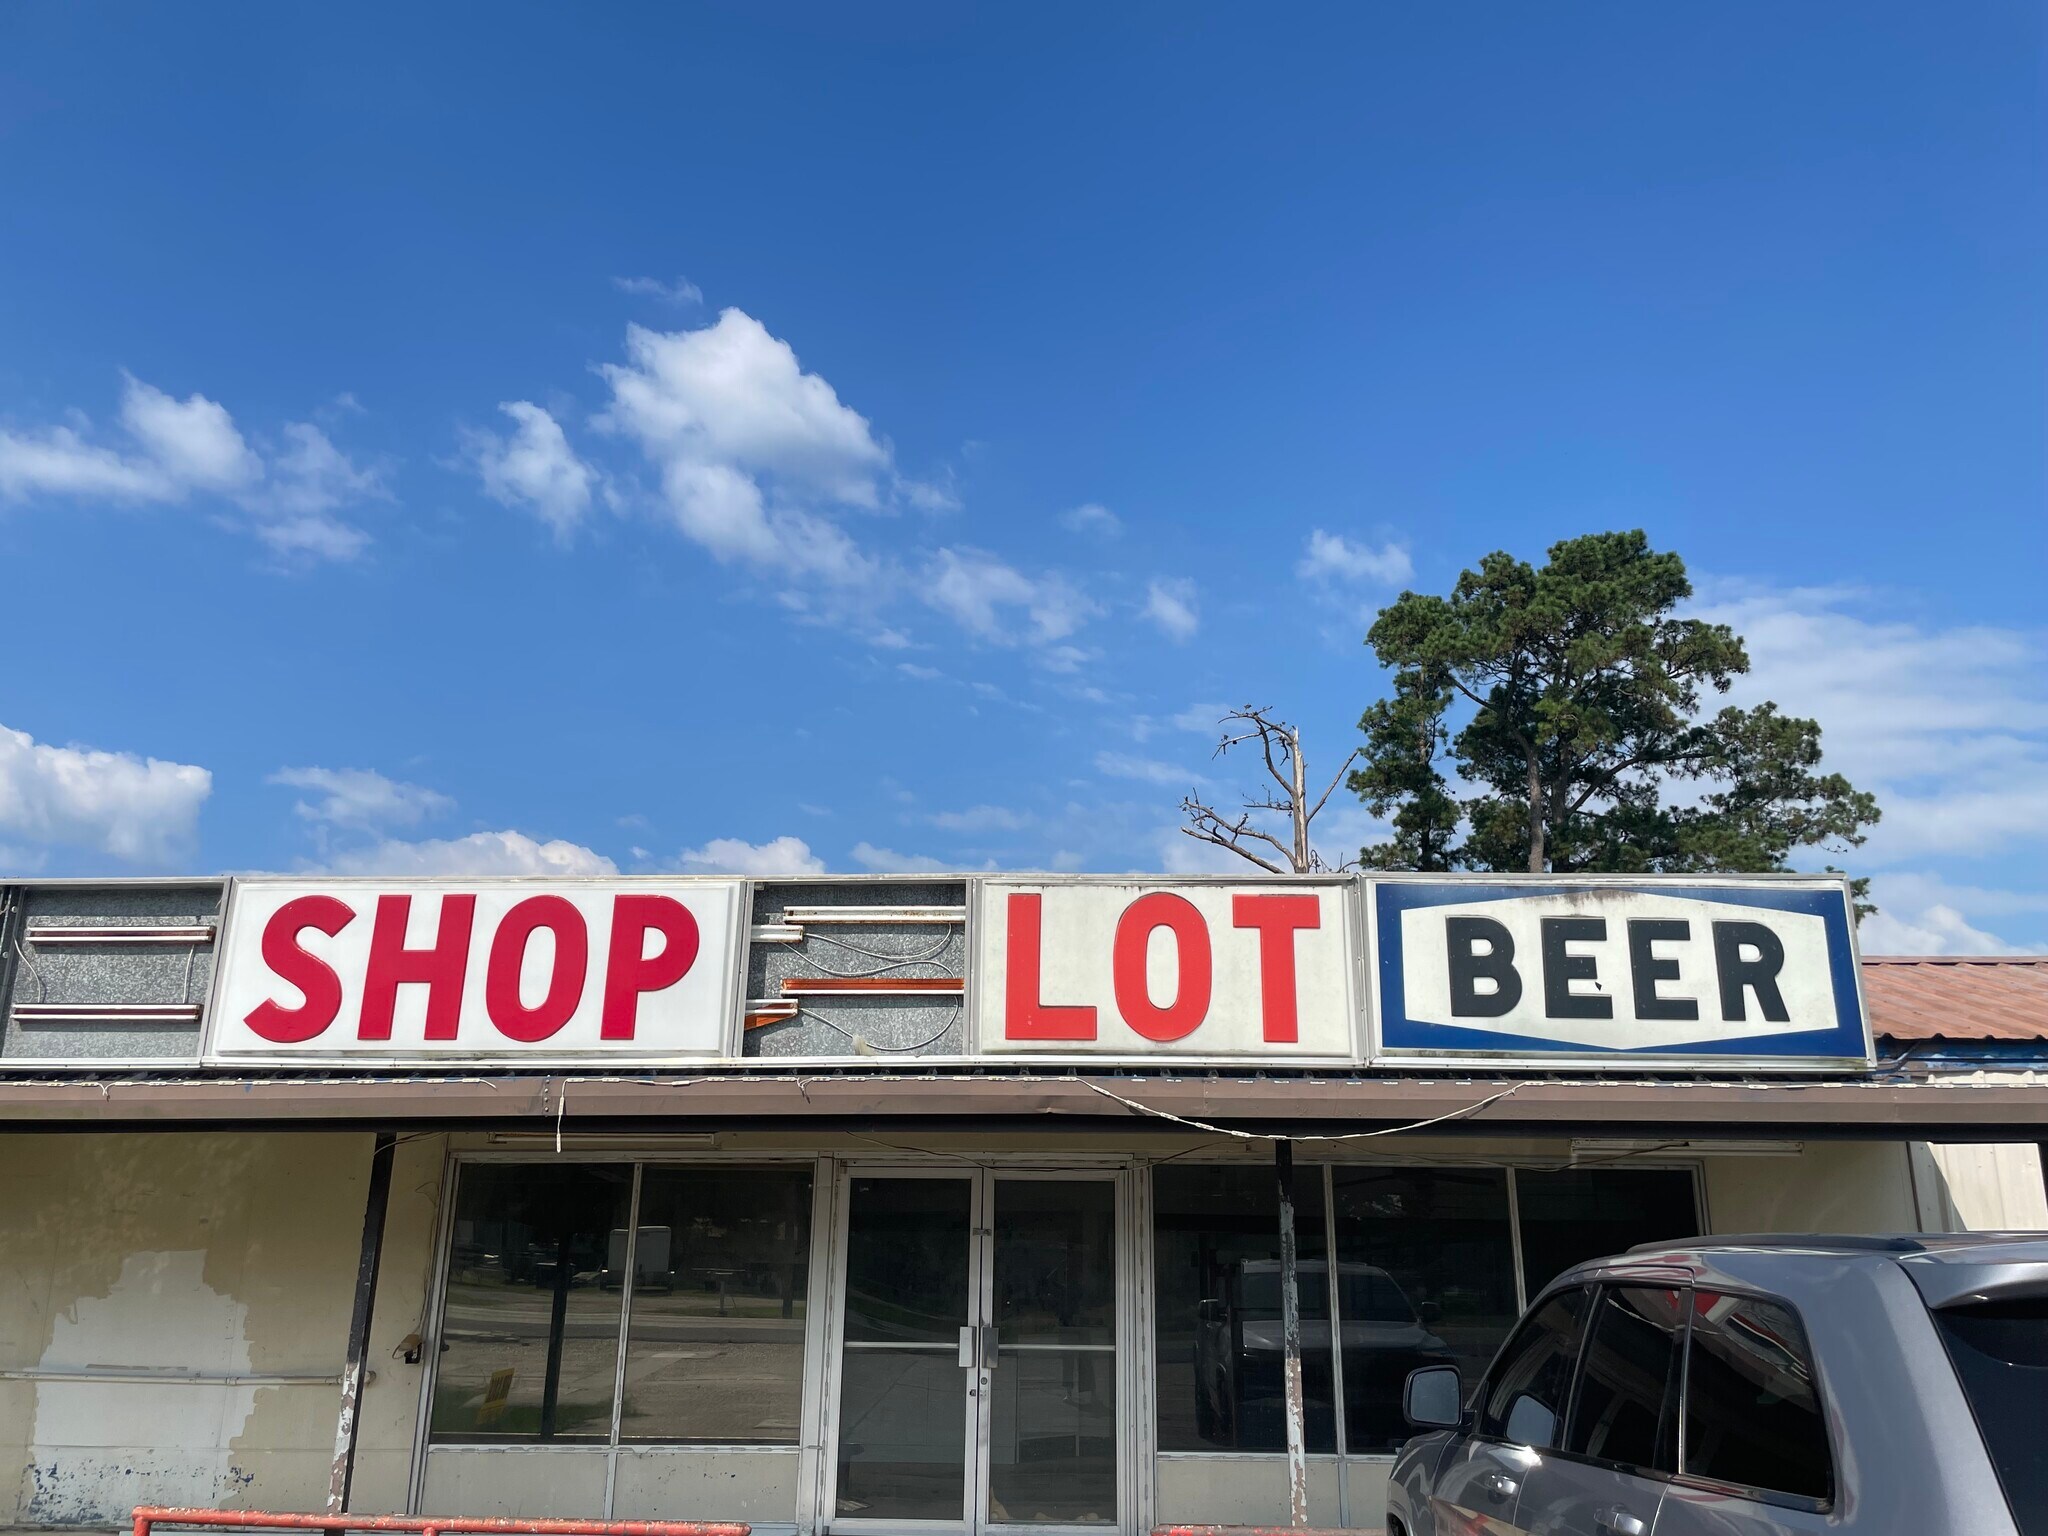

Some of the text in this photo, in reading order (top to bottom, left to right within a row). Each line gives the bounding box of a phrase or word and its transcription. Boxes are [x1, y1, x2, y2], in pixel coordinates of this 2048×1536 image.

[243, 893, 700, 1044] SHOP
[1005, 892, 1321, 1043] LOT
[1445, 915, 1790, 1022] BEER
